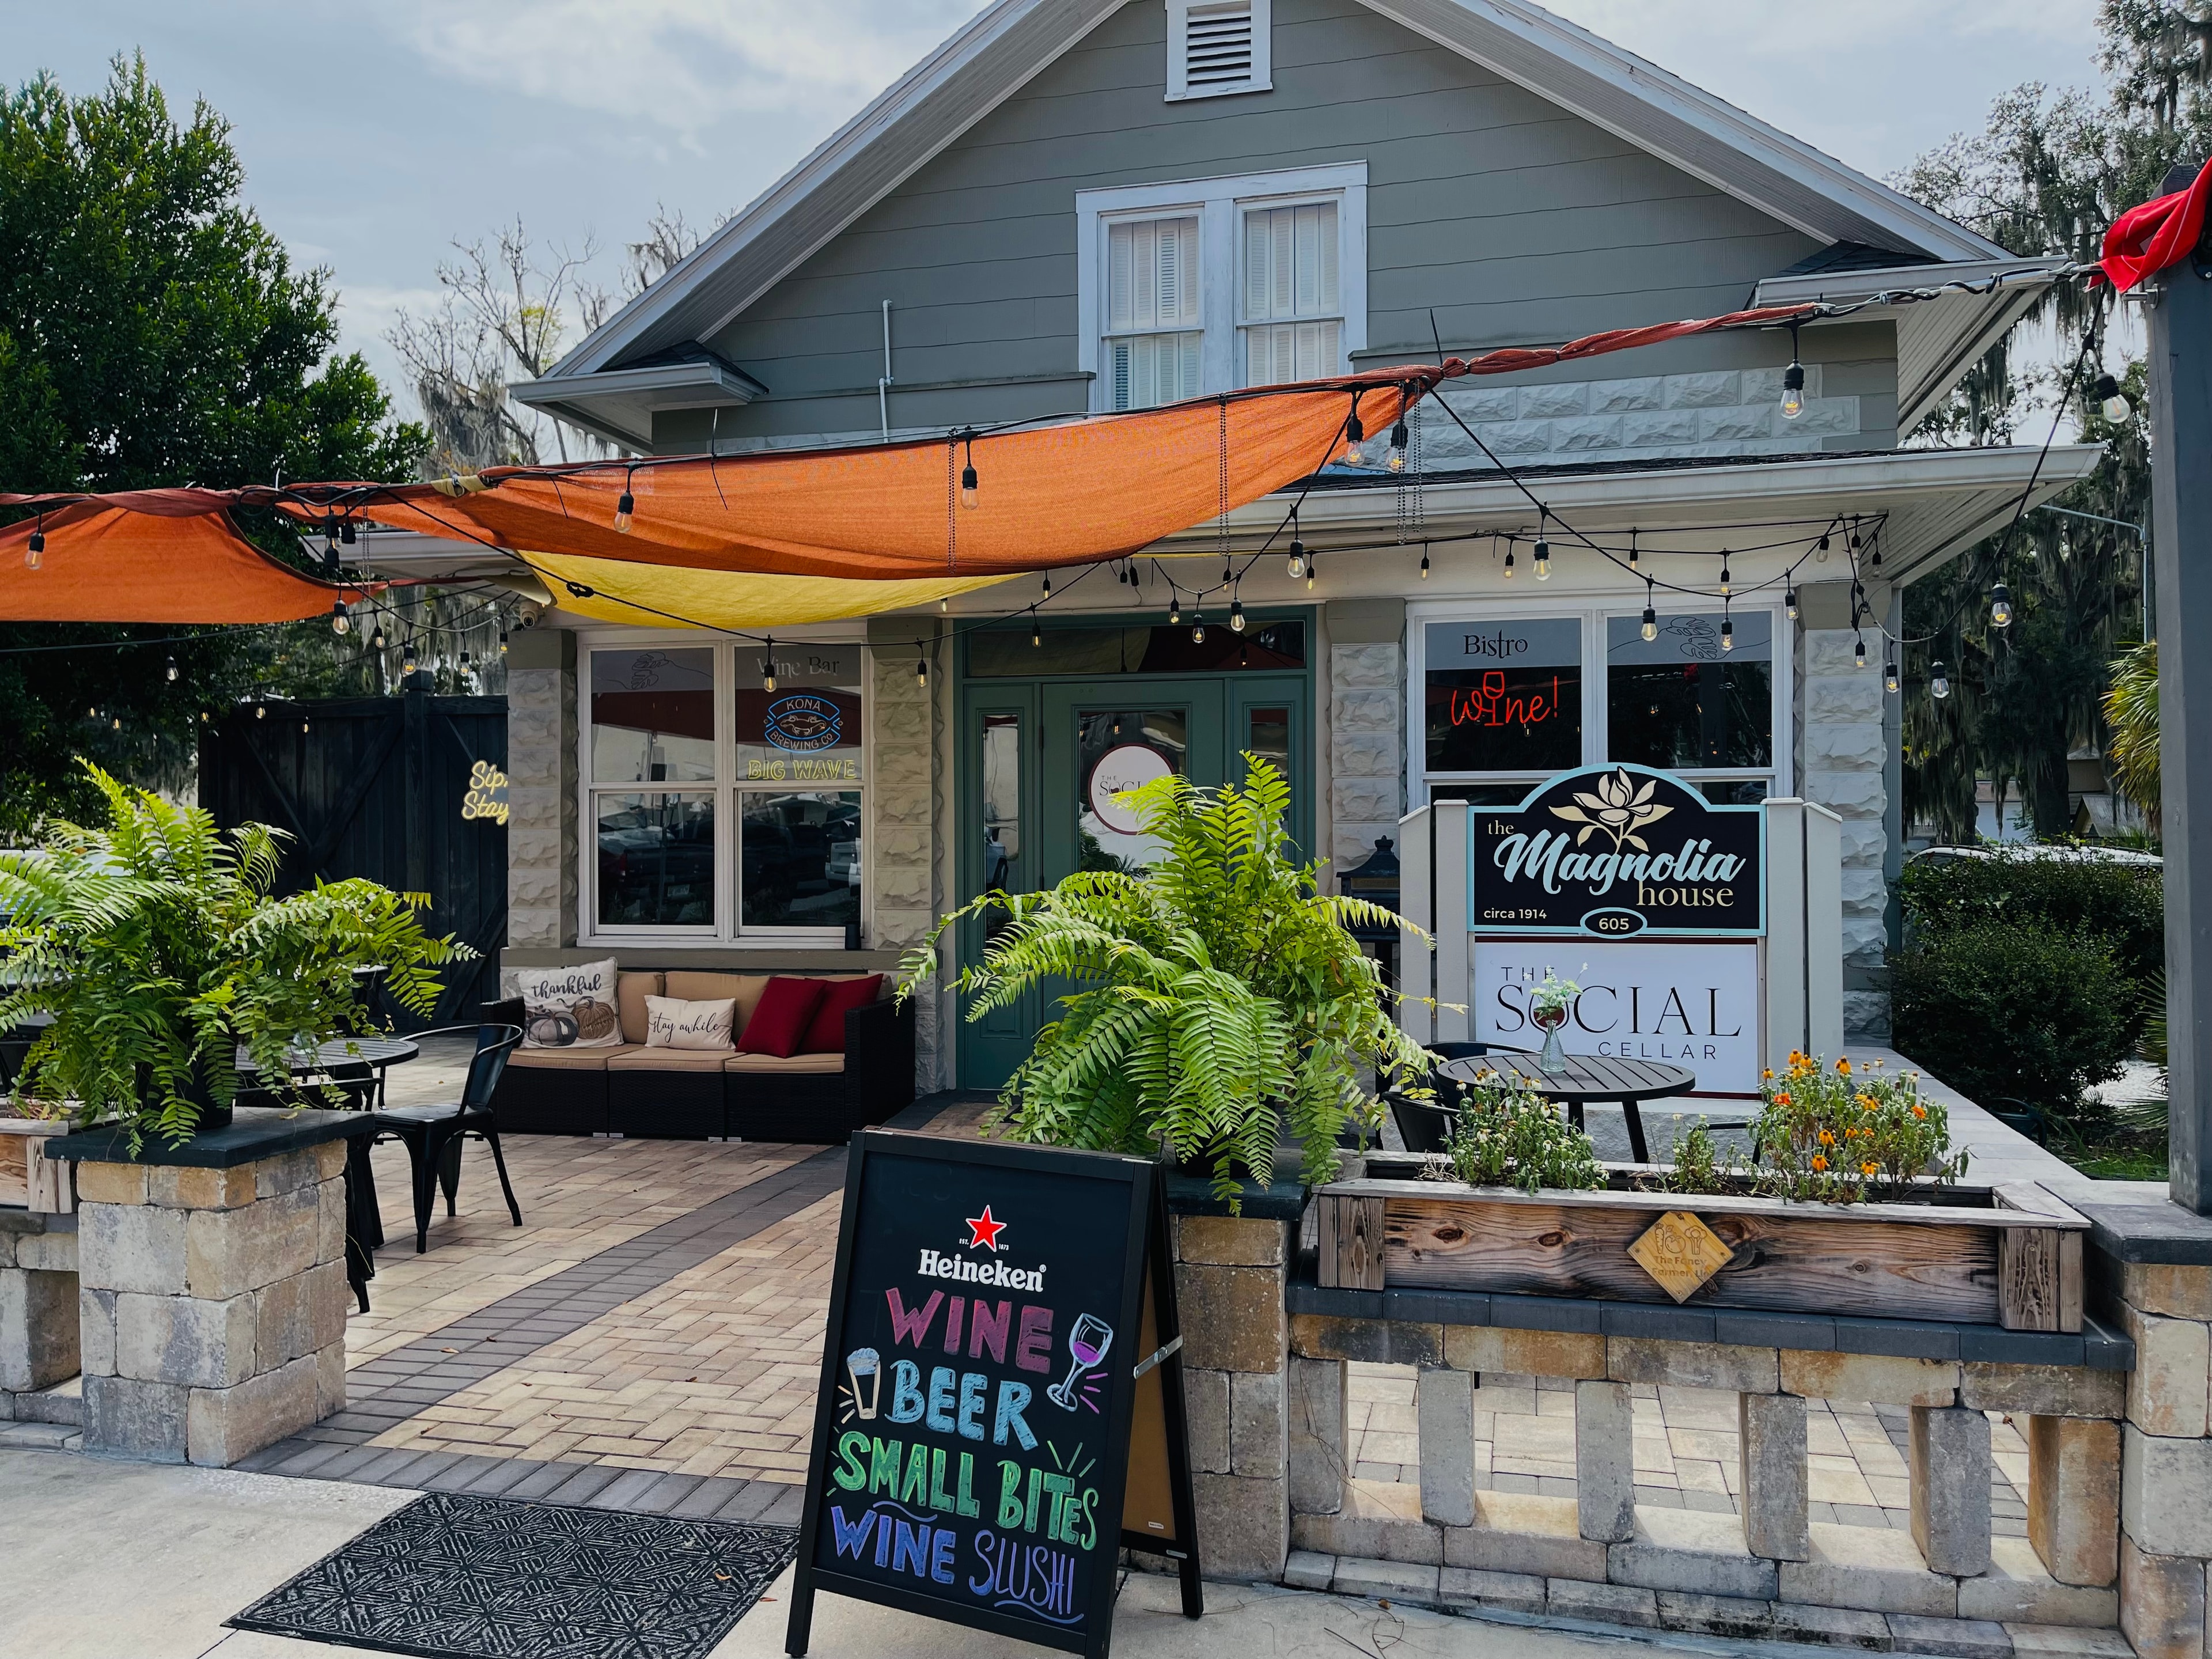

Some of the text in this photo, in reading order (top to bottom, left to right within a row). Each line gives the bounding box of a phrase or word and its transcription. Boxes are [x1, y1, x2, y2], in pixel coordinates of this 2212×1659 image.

[1463, 629, 1528, 659] Bistro
[808, 657, 839, 676] Bar
[786, 698, 821, 712] KONA
[770, 730, 819, 750] BREWING
[748, 759, 857, 780] BIG WAVE
[1488, 820, 1514, 835] the
[1493, 829, 1746, 895] Magnolia
[1637, 881, 1734, 907] house
[1483, 907, 1547, 920] circa 1914
[1599, 917, 1630, 931] 605
[531, 974, 602, 999] thankful
[649, 1012, 732, 1043] stay awhile
[1598, 1041, 1716, 1059] CELLAR
[918, 1249, 1044, 1293] Heineken
[1654, 1256, 1707, 1266] The Fancy
[886, 1287, 1054, 1374] WINE
[885, 1359, 1038, 1450] BEER
[833, 1430, 980, 1519] SMALL
[831, 1505, 1075, 1615] WINE SLUSHI
